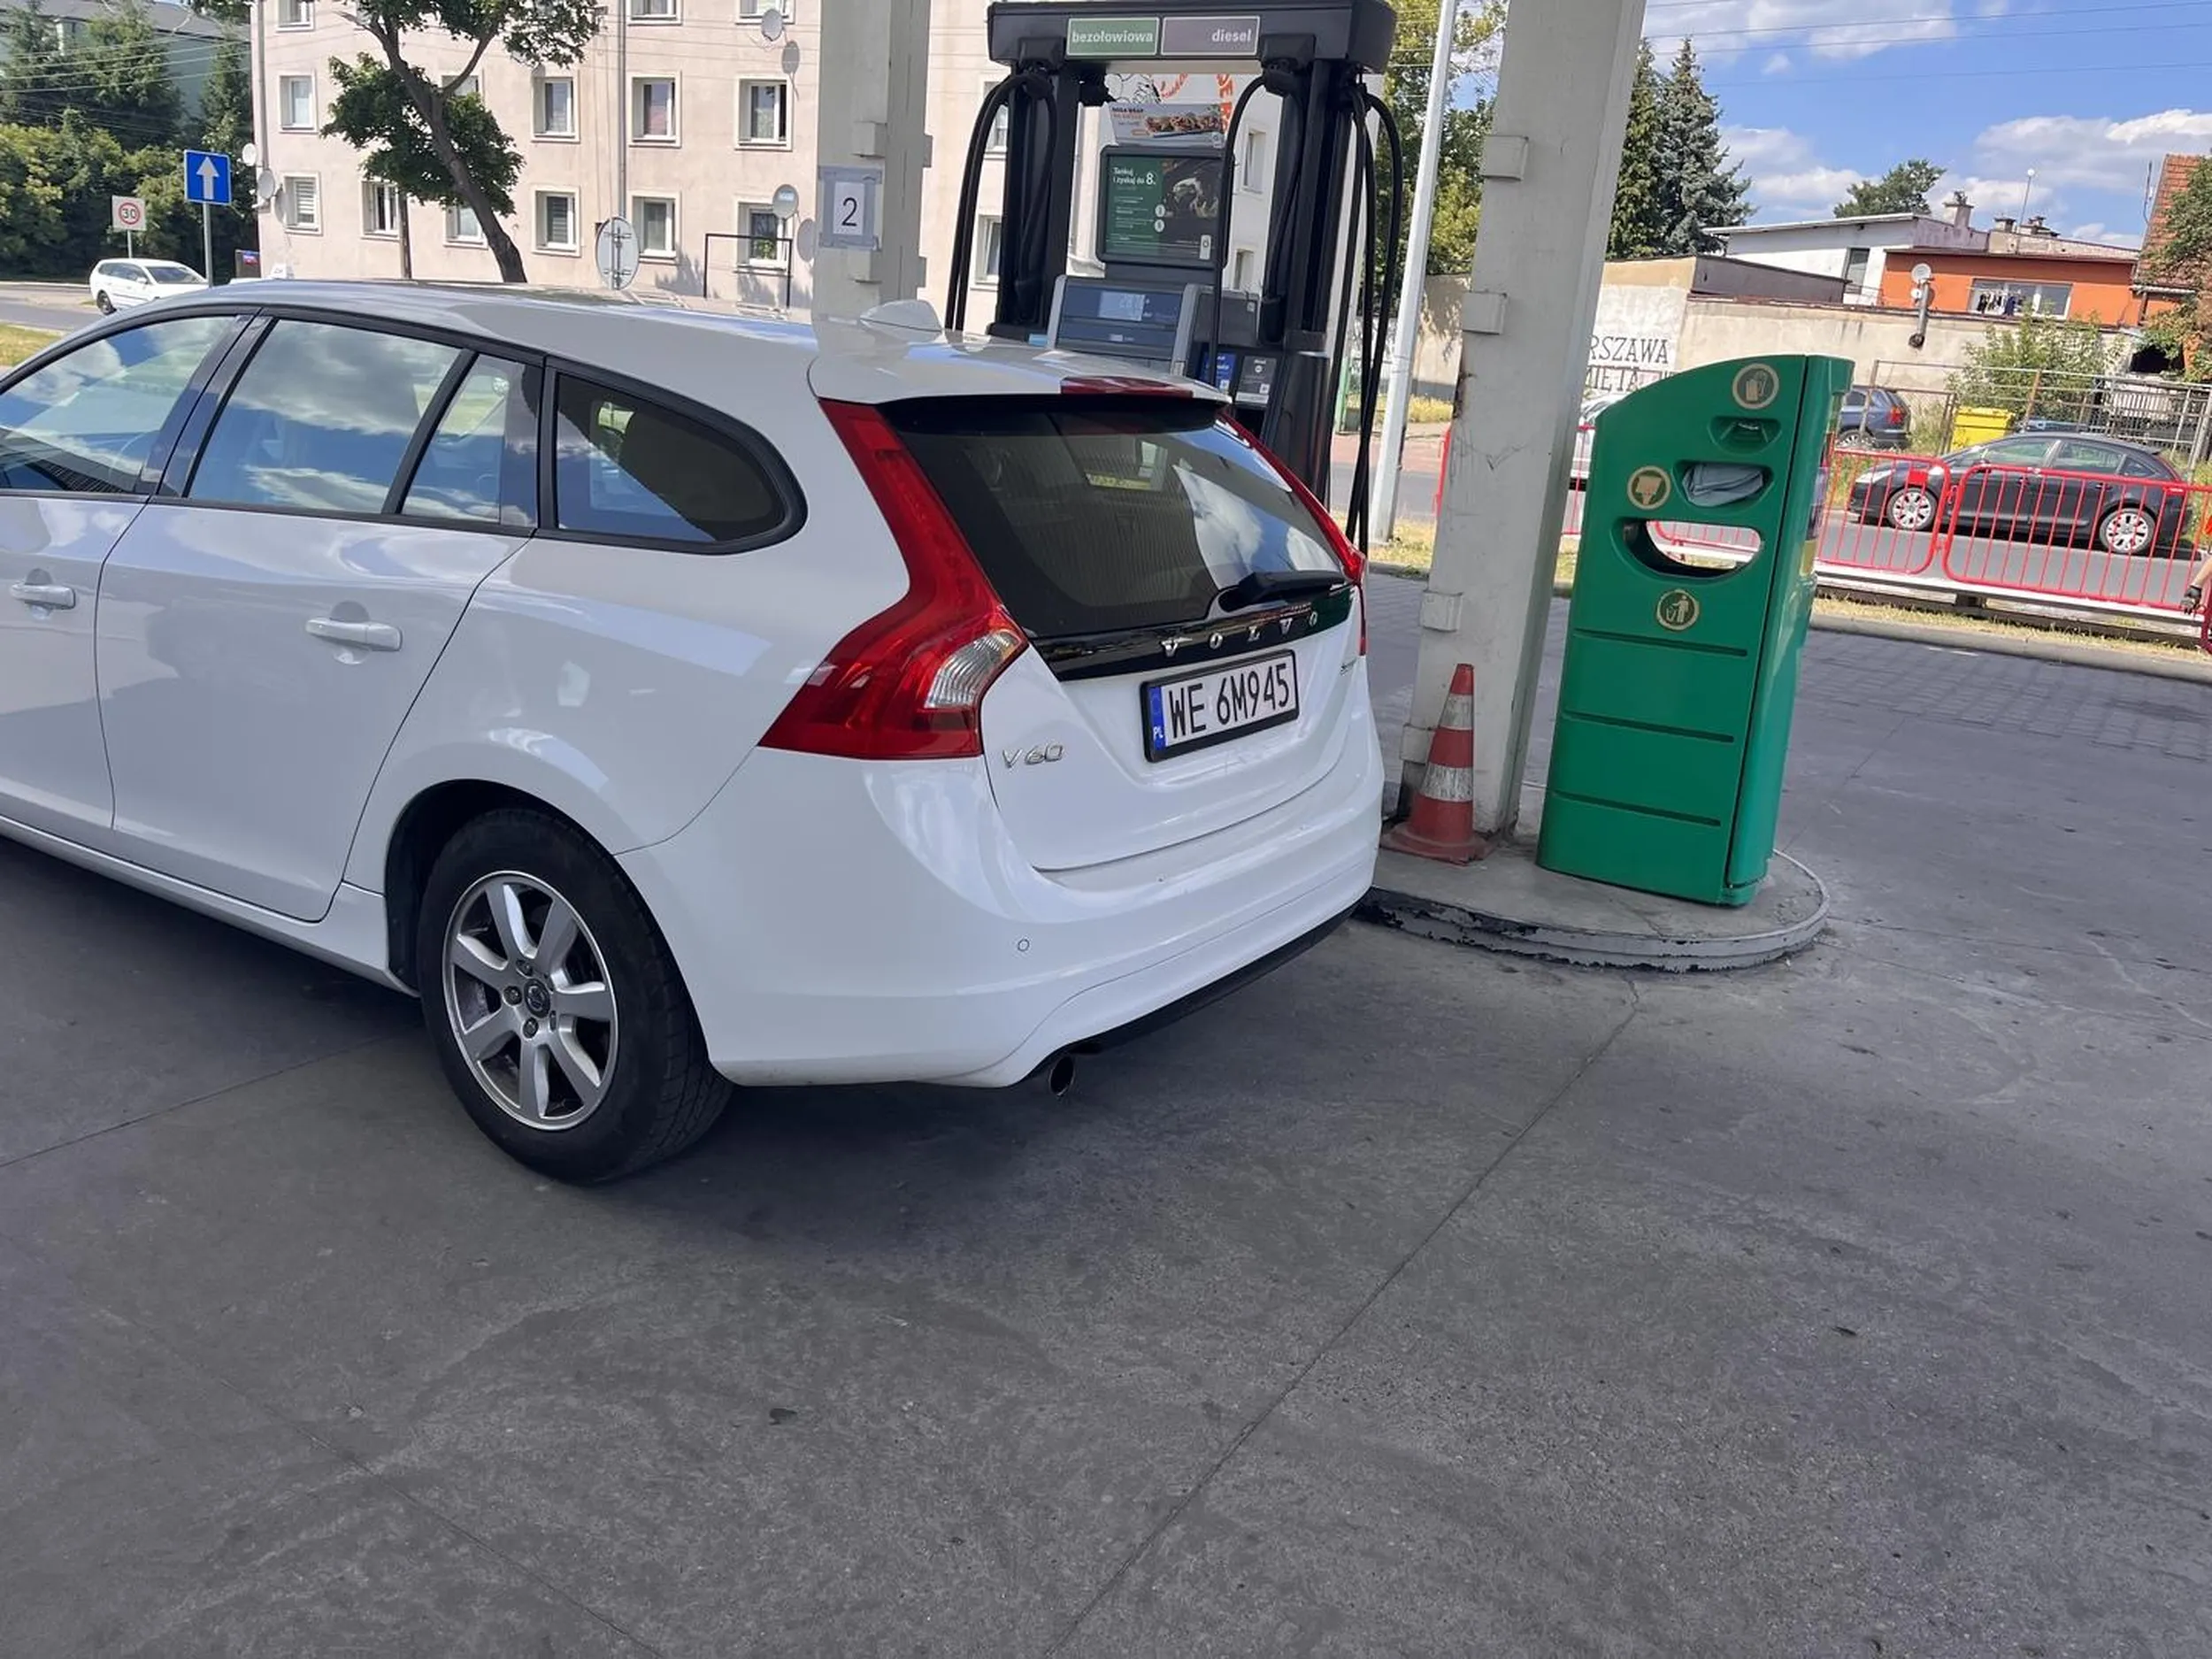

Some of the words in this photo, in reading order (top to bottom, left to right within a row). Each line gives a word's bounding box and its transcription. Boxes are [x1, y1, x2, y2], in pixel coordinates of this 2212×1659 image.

[1211, 29, 1252, 42] diesel
[122, 208, 137, 219] 30
[841, 197, 857, 227] 2
[1590, 335, 1669, 365] RSZAWA
[1160, 611, 1318, 657] VOLVO
[1169, 682, 1207, 739] WE
[1217, 663, 1290, 725] 6M945
[1154, 726, 1164, 740] PL
